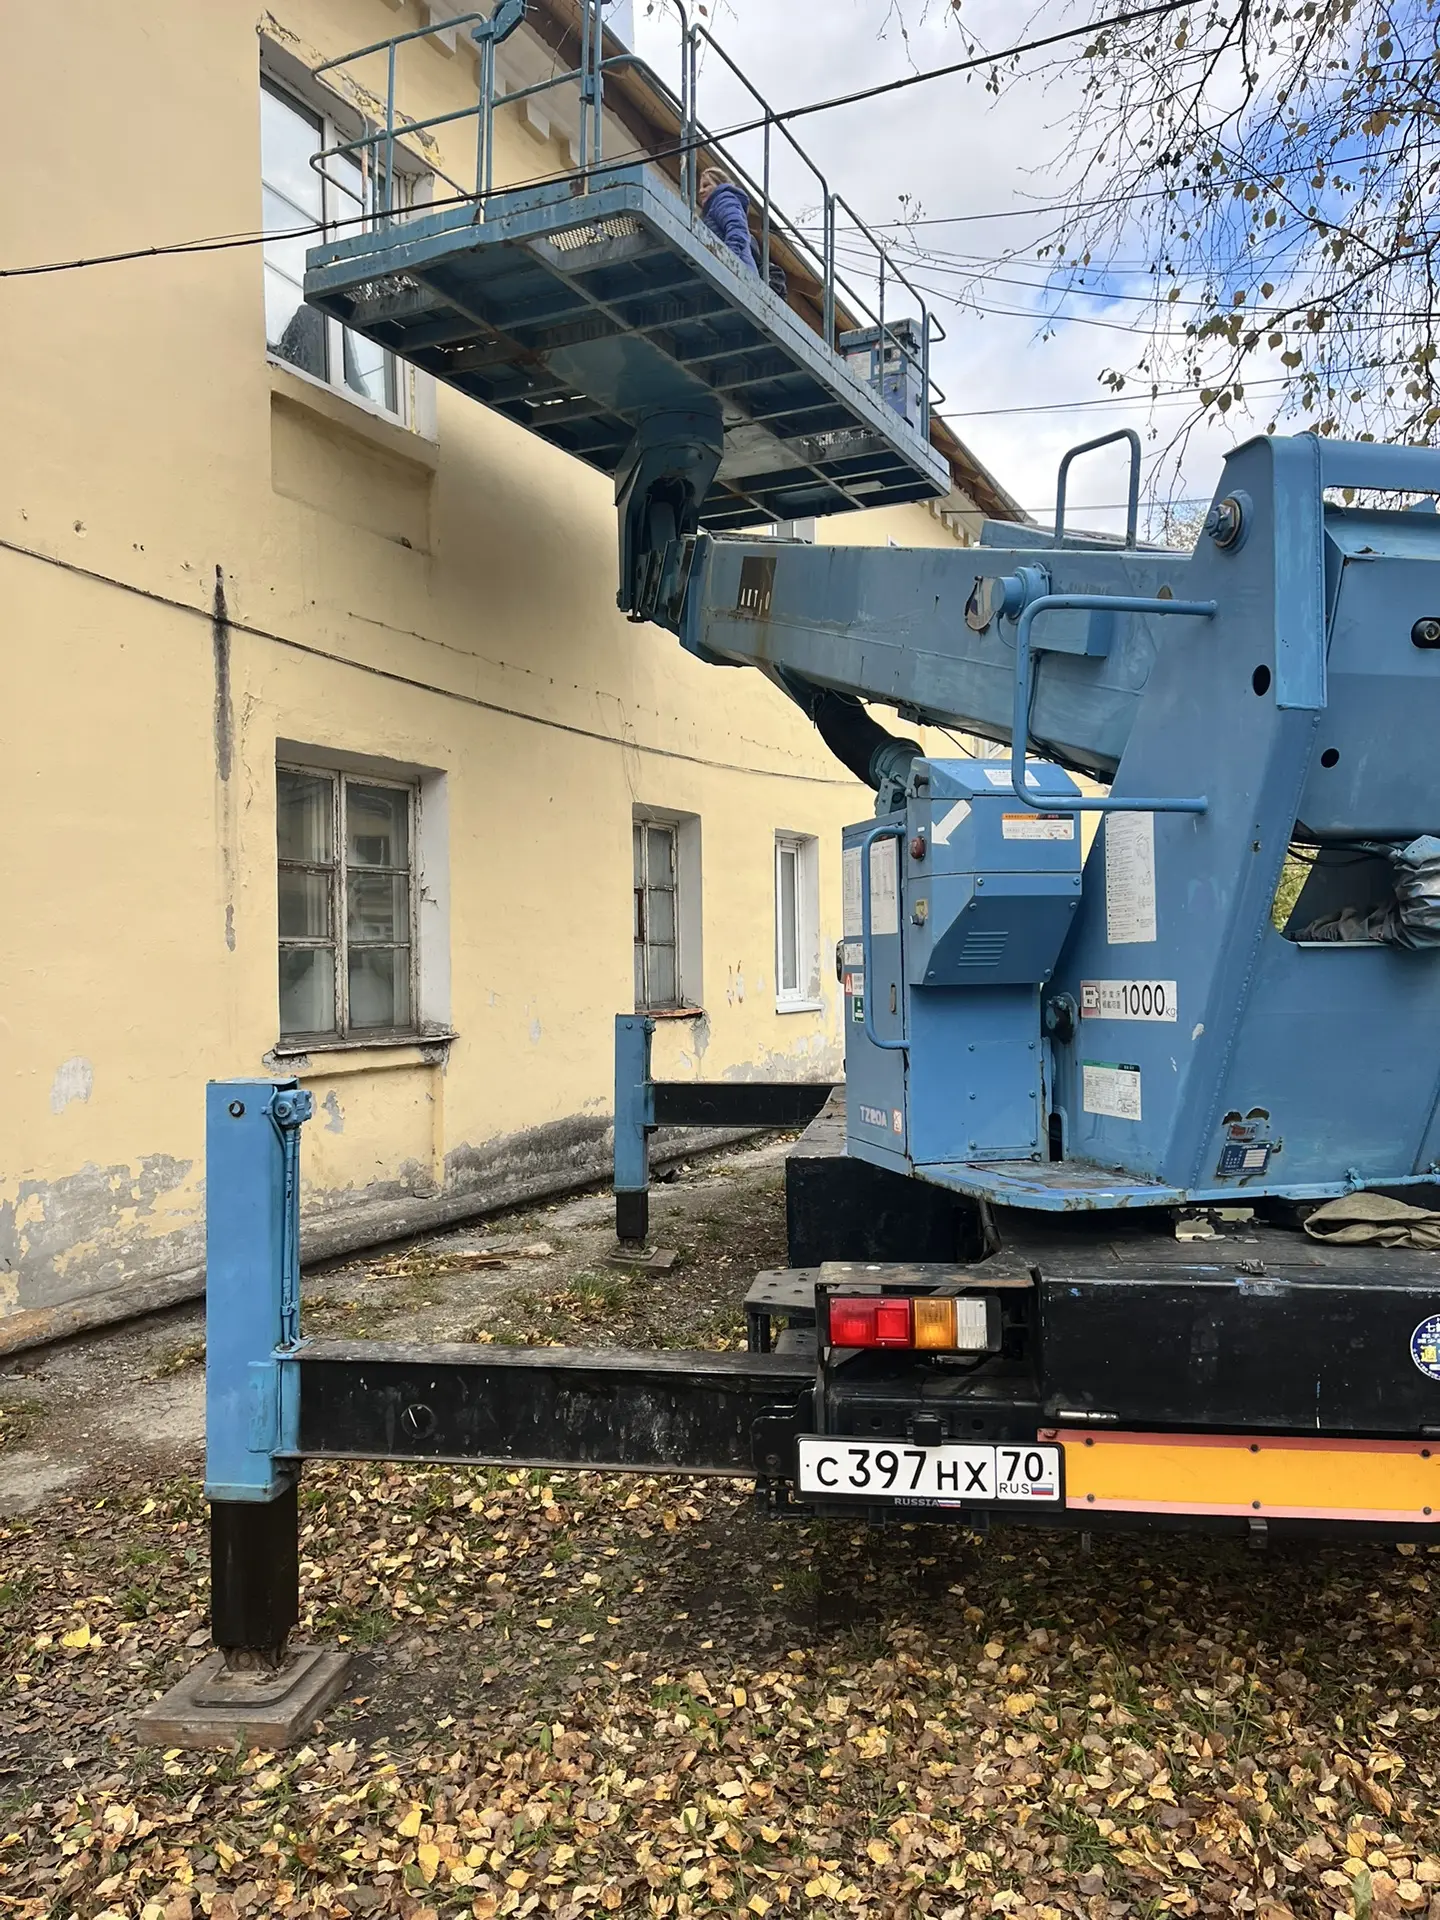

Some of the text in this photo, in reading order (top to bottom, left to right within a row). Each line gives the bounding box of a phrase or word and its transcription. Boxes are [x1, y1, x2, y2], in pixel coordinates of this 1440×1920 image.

[1122, 984, 1165, 1016] 1000
[1001, 1451, 1044, 1481] 70
[999, 1483, 1030, 1494] RUS
[894, 1497, 939, 1507] RUSSIA
